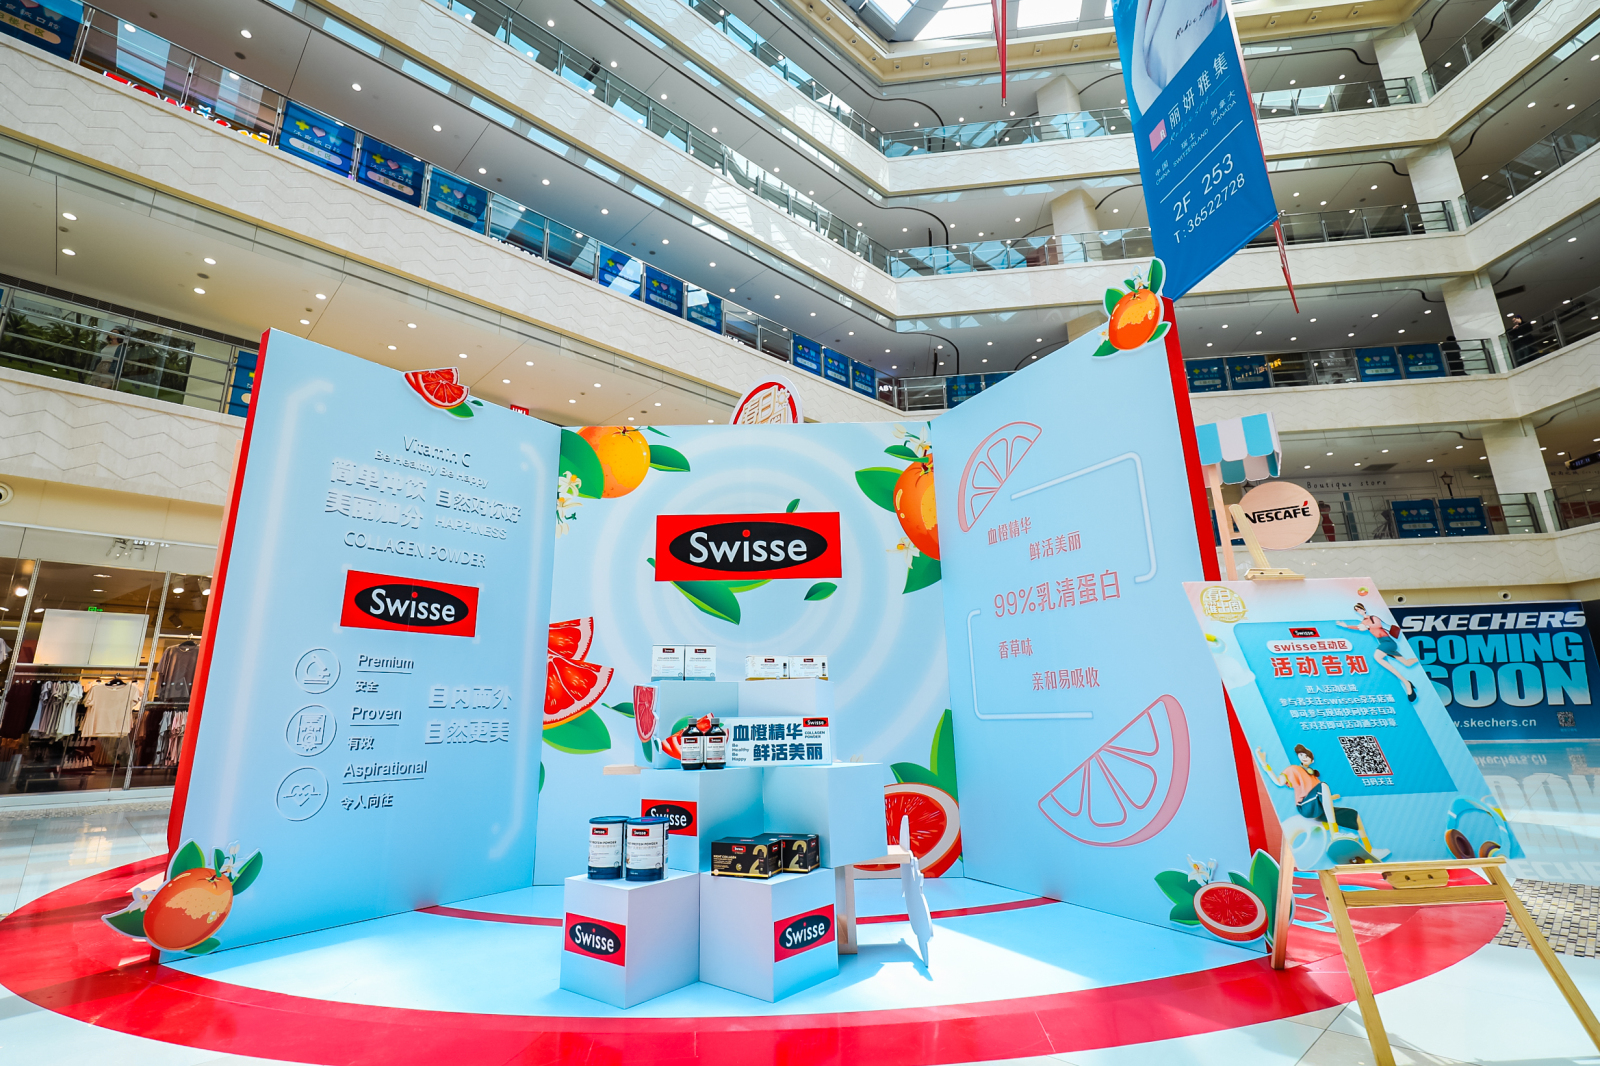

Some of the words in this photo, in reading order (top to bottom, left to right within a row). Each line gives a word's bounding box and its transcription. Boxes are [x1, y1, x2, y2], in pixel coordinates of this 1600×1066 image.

[1168, 51, 1228, 130] 丽妍雅集
[1212, 100, 1237, 126] CANADA
[1172, 128, 1209, 168] SWITZERLAND
[1172, 190, 1191, 222] 2F
[1201, 153, 1234, 195] 253
[403, 434, 458, 464] Vitamin
[461, 452, 471, 467] C
[330, 457, 428, 502] 简单冲饮
[375, 449, 391, 462] Be
[393, 453, 438, 476] Healthy
[439, 466, 454, 479] Be
[456, 470, 489, 489] Happy
[1306, 480, 1352, 490] Boutique
[1360, 479, 1387, 487] store
[324, 488, 424, 529] 美丽加分
[435, 487, 522, 524] 自然对你好
[434, 514, 507, 540] HAPPINESS
[987, 516, 1032, 545] 血橙精华
[343, 531, 425, 559] COLLAGEN
[428, 545, 486, 568] POWDER
[689, 529, 808, 564] Swisse
[1029, 530, 1082, 561] 鲜活美丽
[369, 588, 456, 622] Swisse
[993, 569, 1121, 618] 99%乳清蛋白
[1401, 610, 1586, 633] SKECHERS
[998, 637, 1034, 659] 香草味
[1274, 640, 1348, 652] swisse互动区
[1406, 631, 1586, 665] COMING
[357, 654, 414, 670] Premium
[1270, 654, 1369, 678] 活动告知
[354, 680, 380, 694] 安全
[1032, 666, 1100, 691] 亲和易吸收
[428, 685, 513, 709] 自内而外
[350, 705, 402, 721] Proven
[348, 736, 375, 751] 有效
[424, 719, 510, 745] 自然更美
[732, 722, 803, 742] 血橙精华
[753, 743, 823, 761] 鲜活美丽
[343, 760, 428, 780] Aspirational
[341, 793, 394, 811] 令人向往
[574, 924, 614, 953] Swisse
[785, 920, 825, 948] Swisse
